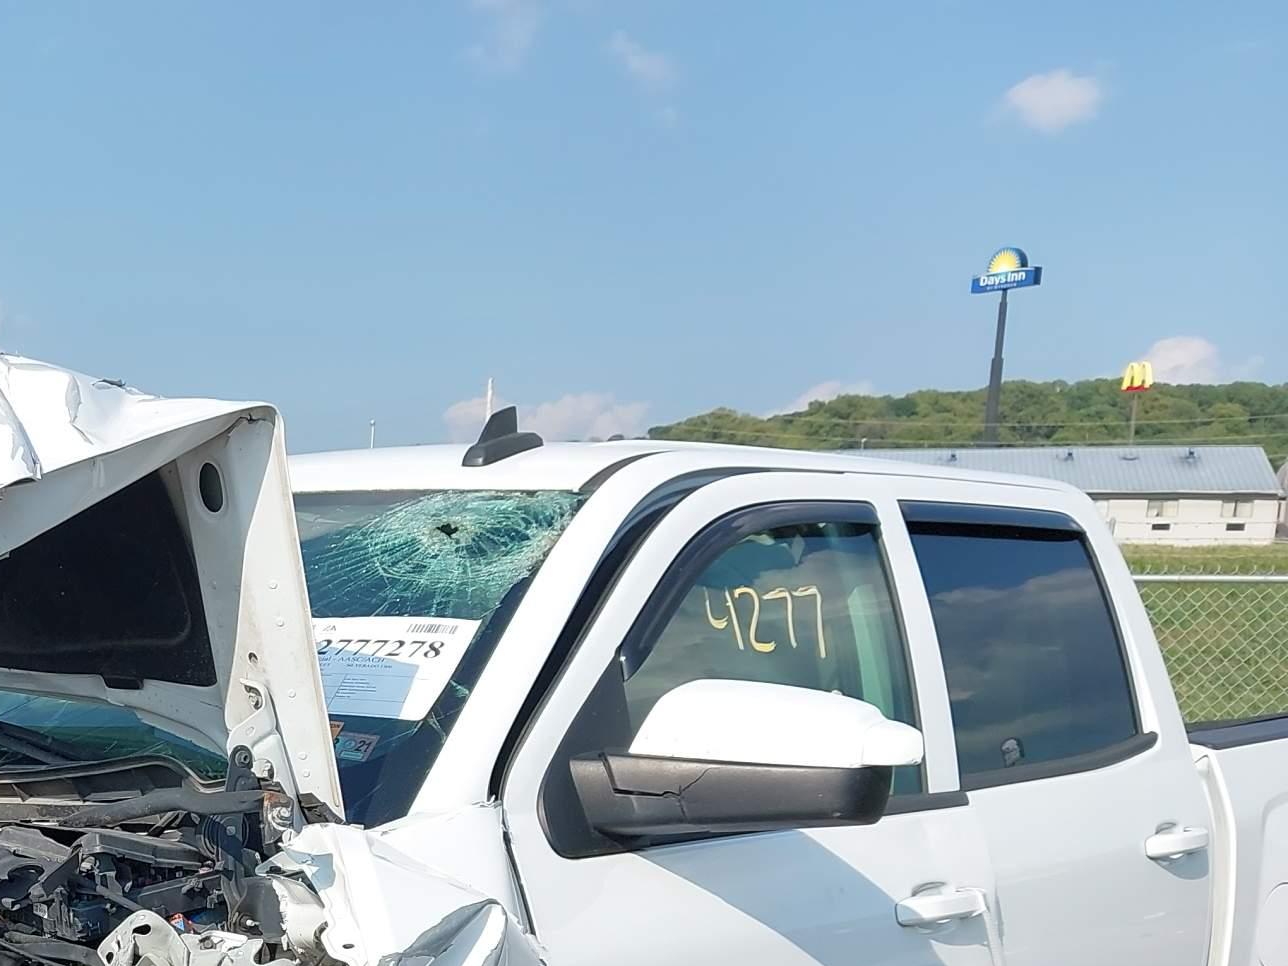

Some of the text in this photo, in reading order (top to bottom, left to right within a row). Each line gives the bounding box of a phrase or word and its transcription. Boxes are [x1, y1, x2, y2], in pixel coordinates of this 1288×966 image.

[980, 271, 1026, 286] Days Inn
[704, 585, 827, 658] 4277
